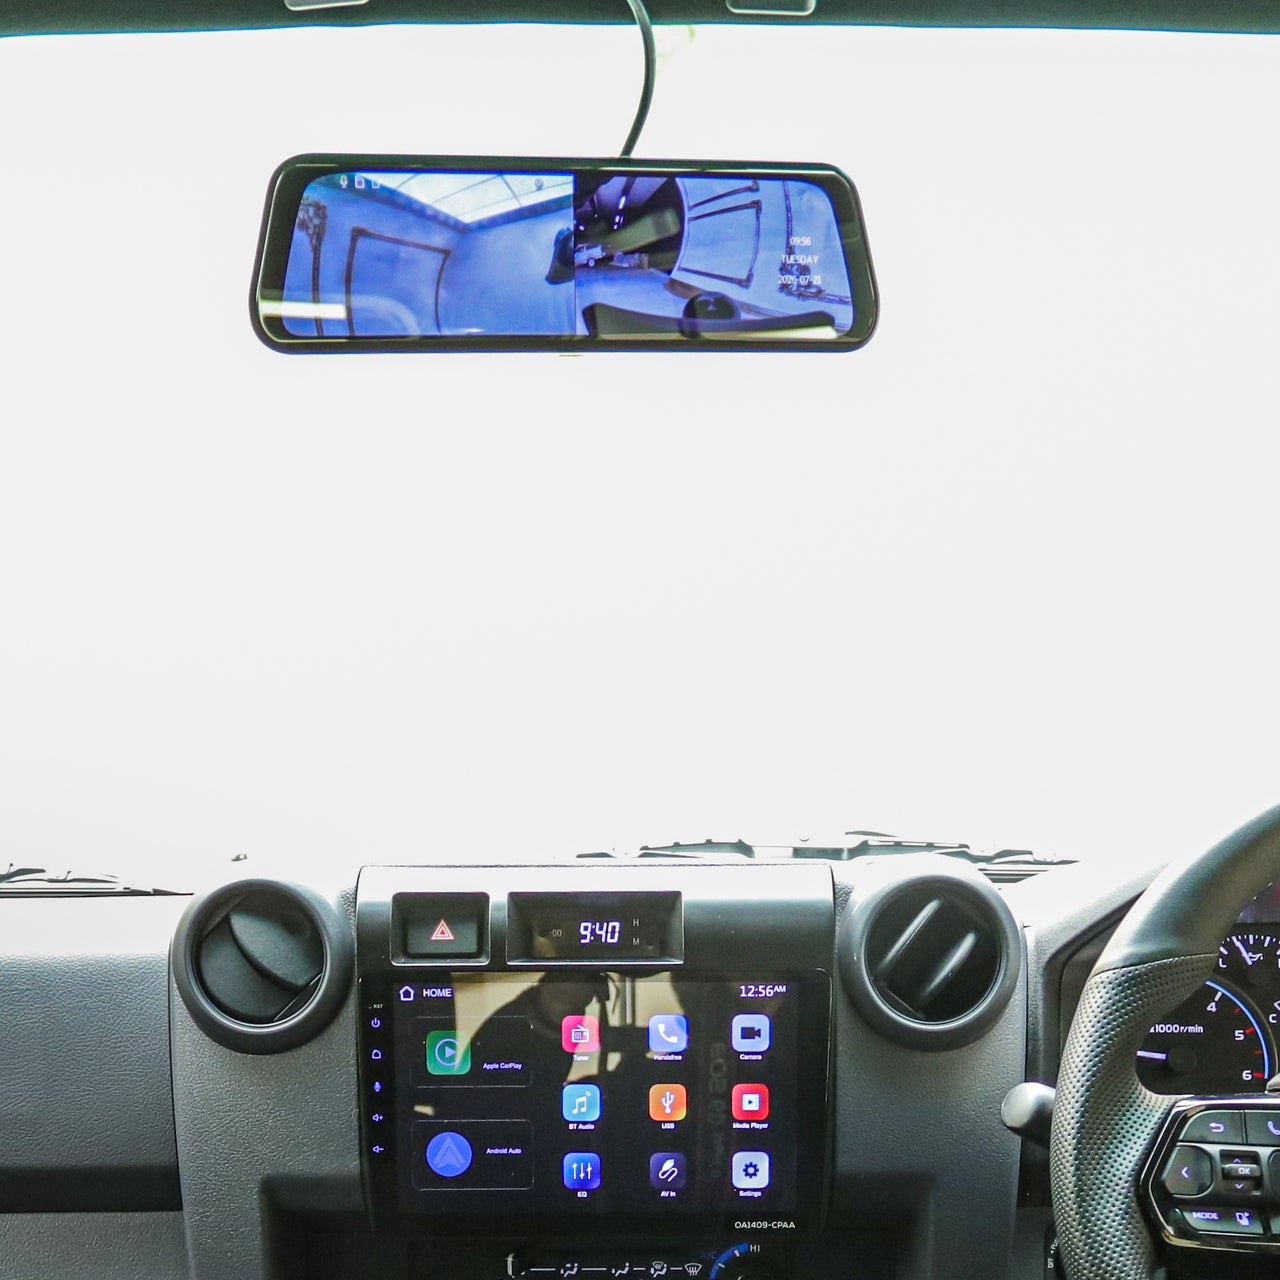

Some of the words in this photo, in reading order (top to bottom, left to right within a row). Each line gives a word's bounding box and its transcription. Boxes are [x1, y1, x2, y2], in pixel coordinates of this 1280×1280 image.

[790, 236, 811, 246] 09:56
[781, 254, 819, 264] TUESDAY
[632, 918, 640, 927] H
[580, 921, 620, 943] 9:40
[632, 937, 640, 946] M
[422, 988, 453, 998] HOME
[1206, 1001, 1217, 1013] 4
[1269, 1013, 1277, 1024] C
[1234, 1029, 1245, 1041] 5
[1241, 1069, 1253, 1081] 6
[1238, 1167, 1251, 1175] OK
[577, 1190, 588, 1198] EQ
[1192, 1211, 1219, 1220] MODE
[750, 1244, 761, 1253] HI
